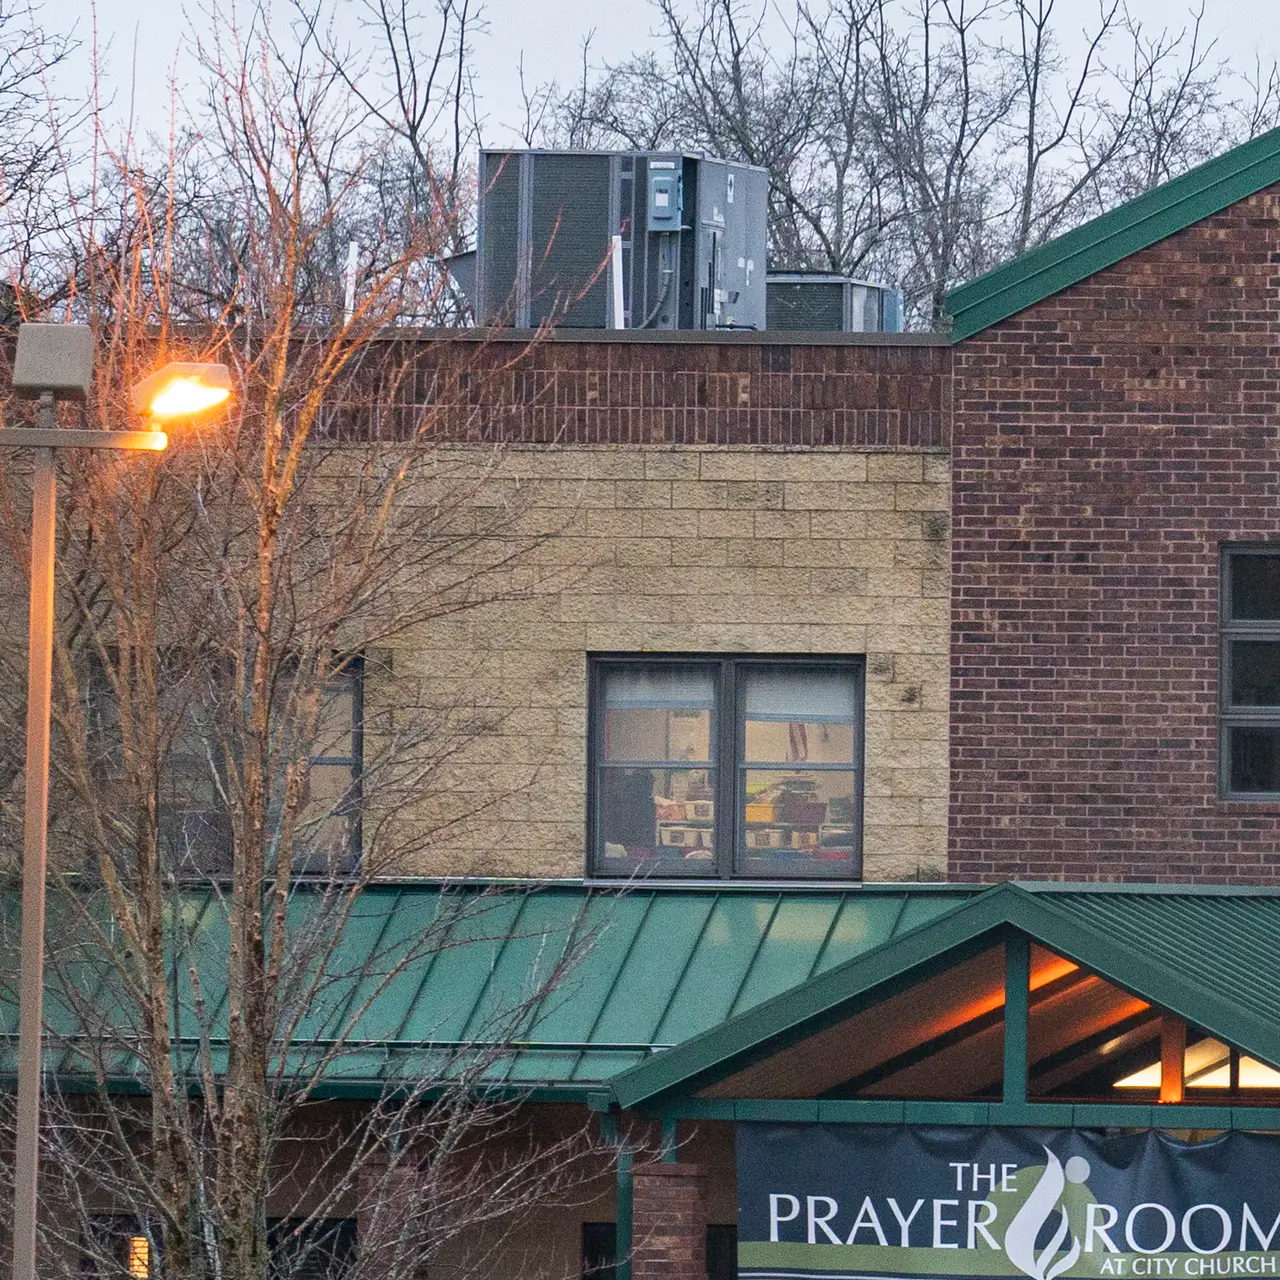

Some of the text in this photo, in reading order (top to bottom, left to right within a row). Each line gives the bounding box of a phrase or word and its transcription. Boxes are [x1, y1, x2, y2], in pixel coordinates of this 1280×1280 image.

[949, 1162, 1018, 1193] THE
[769, 1193, 1002, 1250] PRAYER
[1100, 1256, 1276, 1276] AT CITY CHURCH
